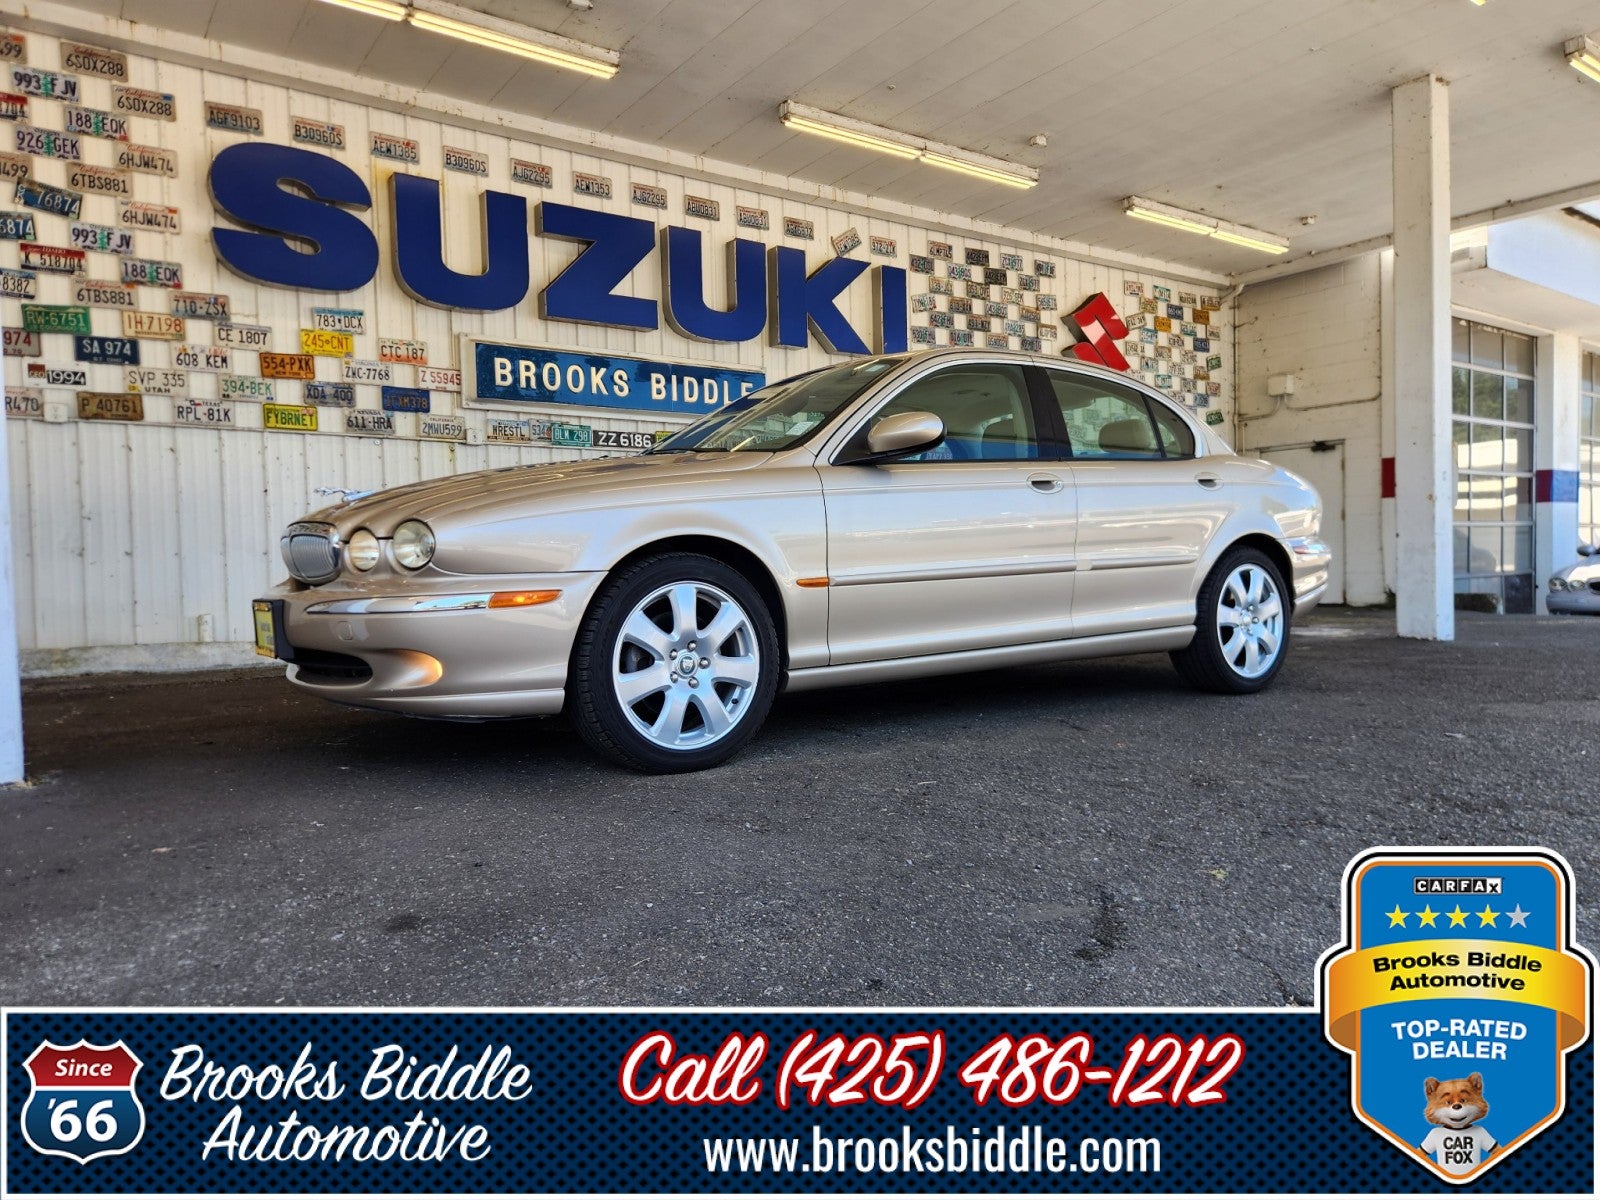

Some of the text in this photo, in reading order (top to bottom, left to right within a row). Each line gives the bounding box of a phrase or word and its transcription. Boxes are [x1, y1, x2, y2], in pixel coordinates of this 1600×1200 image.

[0, 42, 22, 58] 99
[14, 71, 41, 90] 993
[68, 110, 92, 129] 188
[16, 130, 80, 156] 926 GEK
[119, 151, 174, 173] 6HJW474
[71, 172, 129, 194] 6TBS881
[122, 209, 177, 229] 6HJW474
[72, 227, 98, 247] 993
[206, 141, 908, 357] SUZUKI
[123, 262, 147, 279] 188
[77, 288, 134, 306] 6TBS881
[316, 314, 364, 330] 783 DCX
[218, 327, 268, 346] CE 1807
[304, 332, 350, 351] 245 CNT
[82, 340, 132, 356] SA 974
[380, 345, 425, 361] CTC 187
[176, 352, 229, 369] 608 KEM
[48, 370, 85, 385] 1994
[128, 371, 185, 388] SVP 335
[421, 370, 461, 386] Z 55945
[493, 357, 630, 398] BROOKS
[145, 386, 171, 394] UTAH
[306, 386, 353, 402] XDA 400
[81, 398, 138, 413] P 40761
[177, 405, 231, 422] RPL 81K
[266, 410, 314, 427] FYBRNET
[422, 422, 462, 437] 2MWU599
[598, 432, 617, 446] ZZ
[619, 433, 652, 448] 6186
